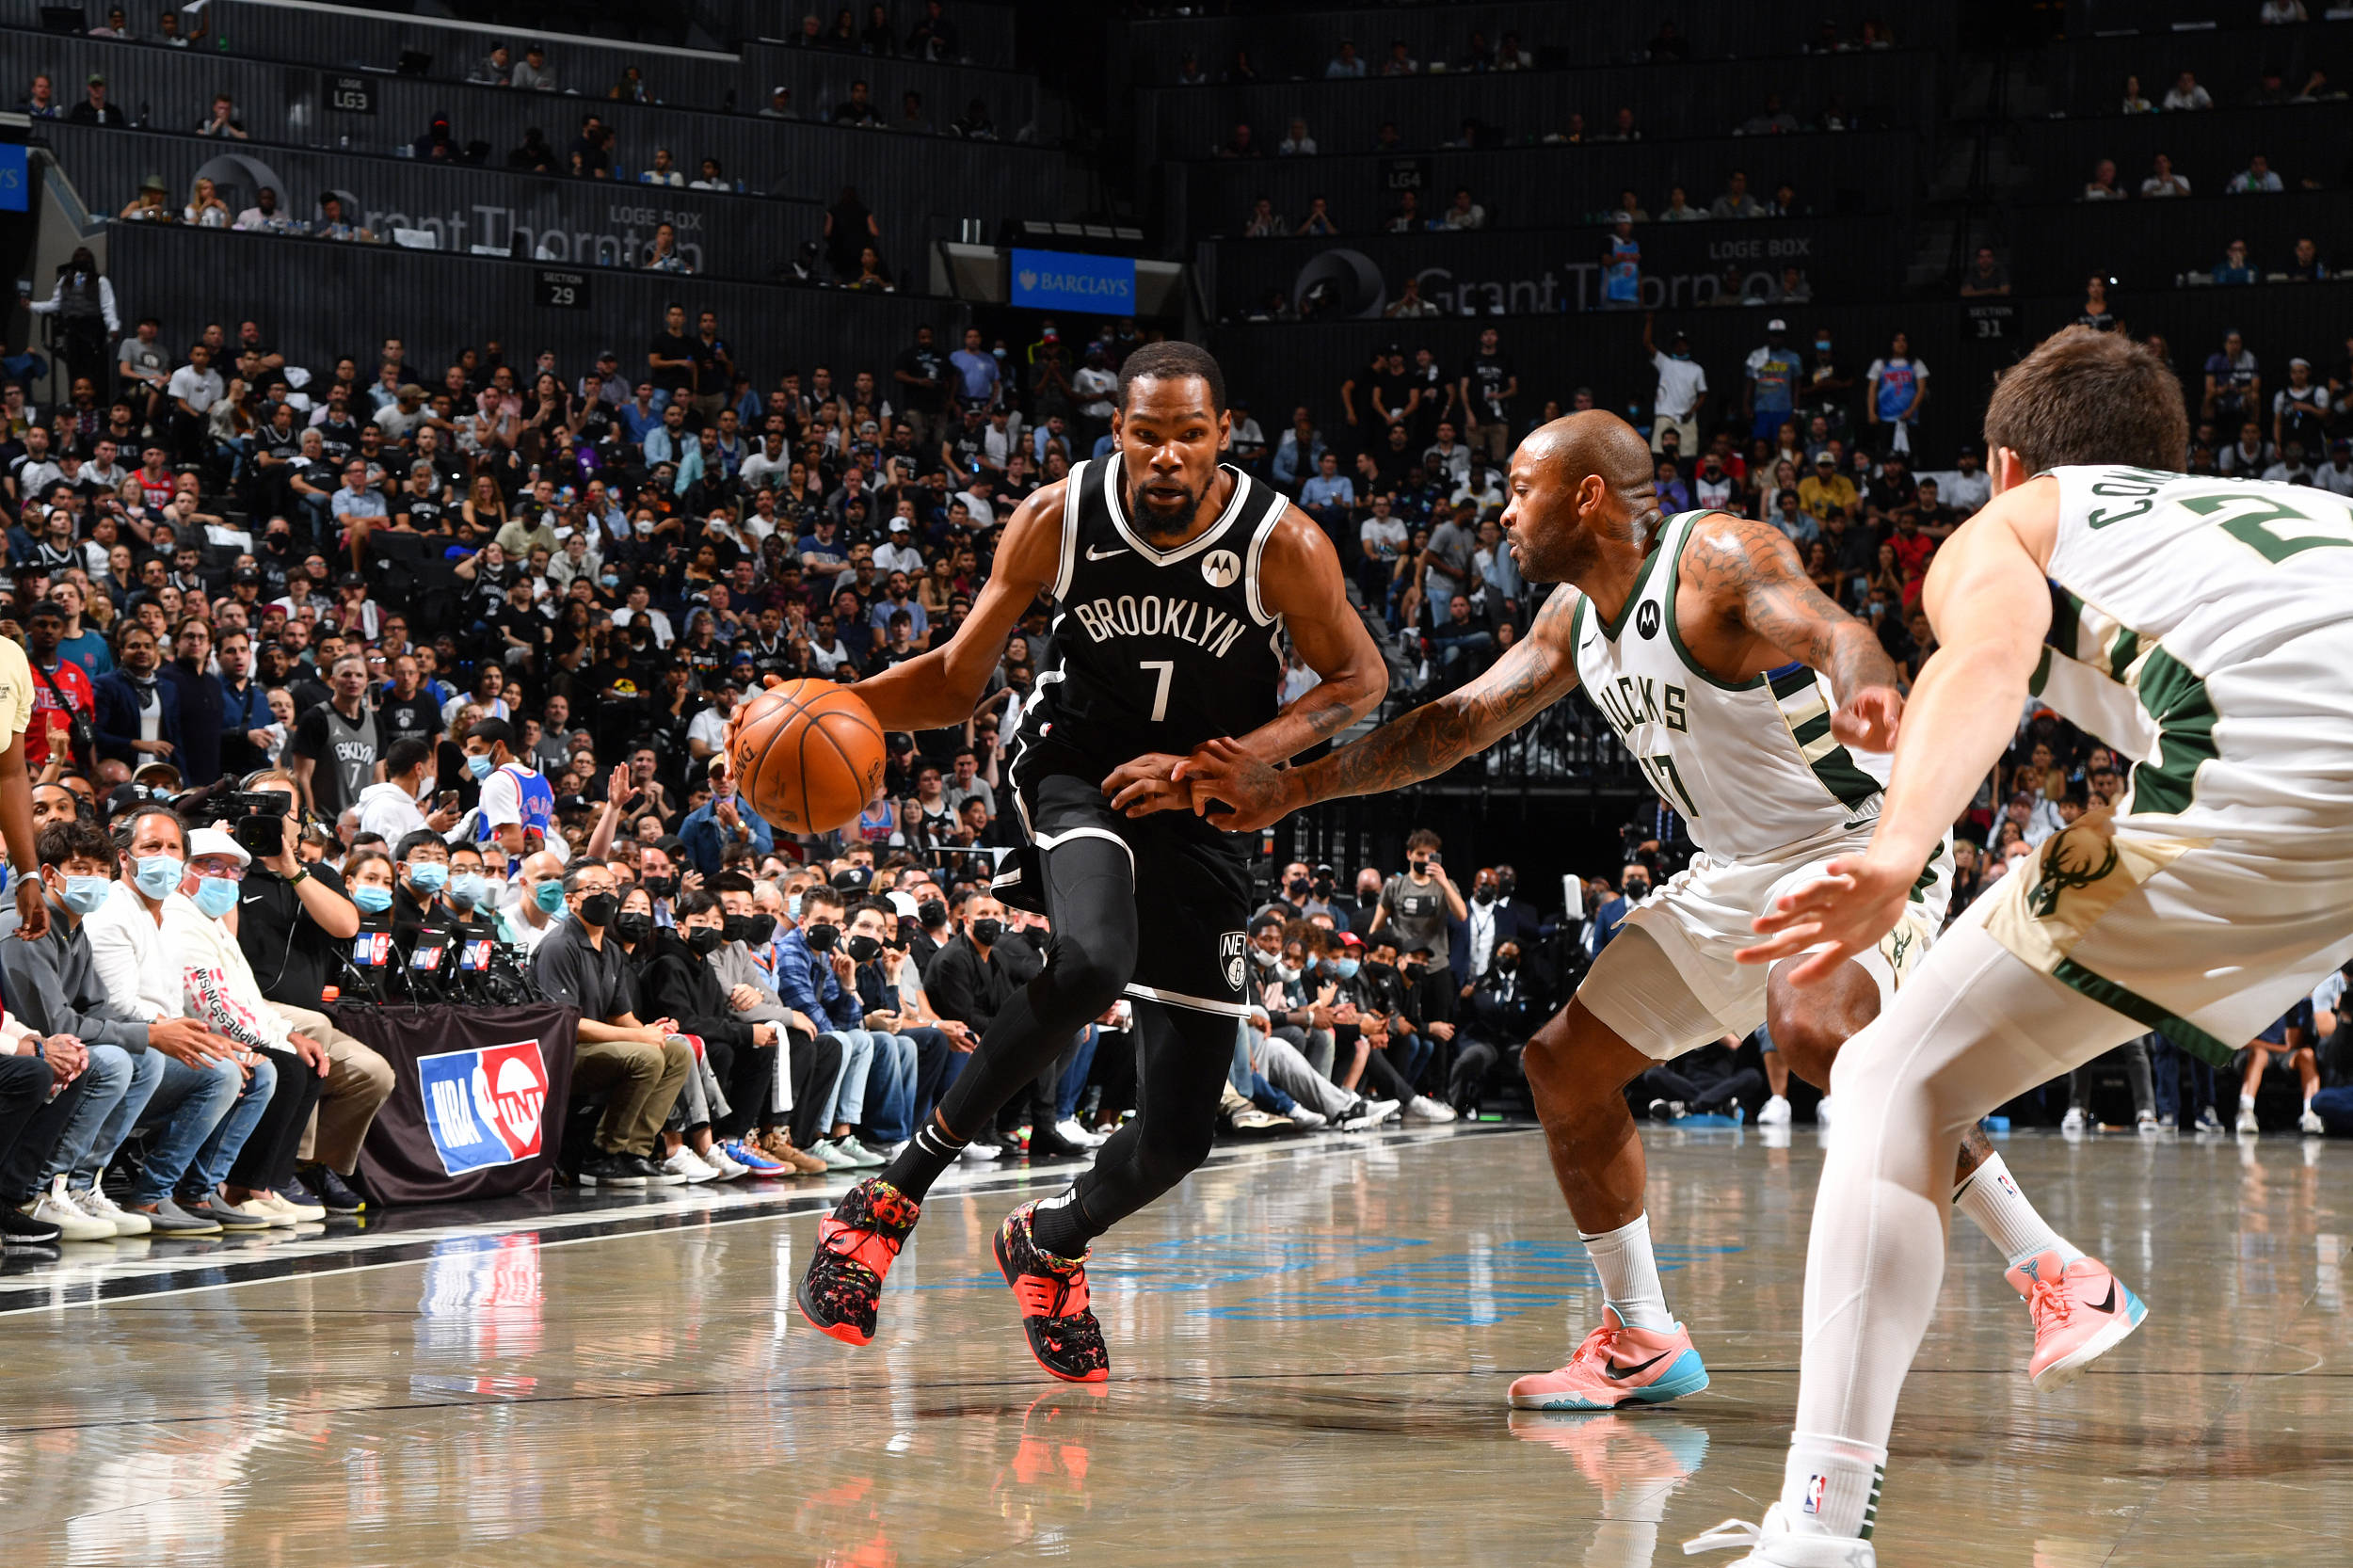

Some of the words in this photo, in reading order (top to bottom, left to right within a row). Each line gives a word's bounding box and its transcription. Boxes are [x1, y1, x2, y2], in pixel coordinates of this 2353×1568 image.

[333, 89, 368, 111] LG3
[611, 205, 657, 227] LOGE
[1709, 241, 1763, 261] LOGE
[1767, 237, 1813, 257] BOX
[551, 285, 576, 306] 29
[1040, 271, 1129, 298] BARCLAYS
[1977, 319, 2003, 339] 31
[2177, 493, 2353, 565] 2
[1074, 594, 1247, 659] BROOKLYN
[1140, 661, 1174, 722] 7
[1599, 674, 1688, 739] UCKS
[334, 741, 376, 765] BKLYN
[351, 763, 362, 789] 7
[1639, 753, 1701, 819] 17
[430, 1077, 483, 1149] NBA
